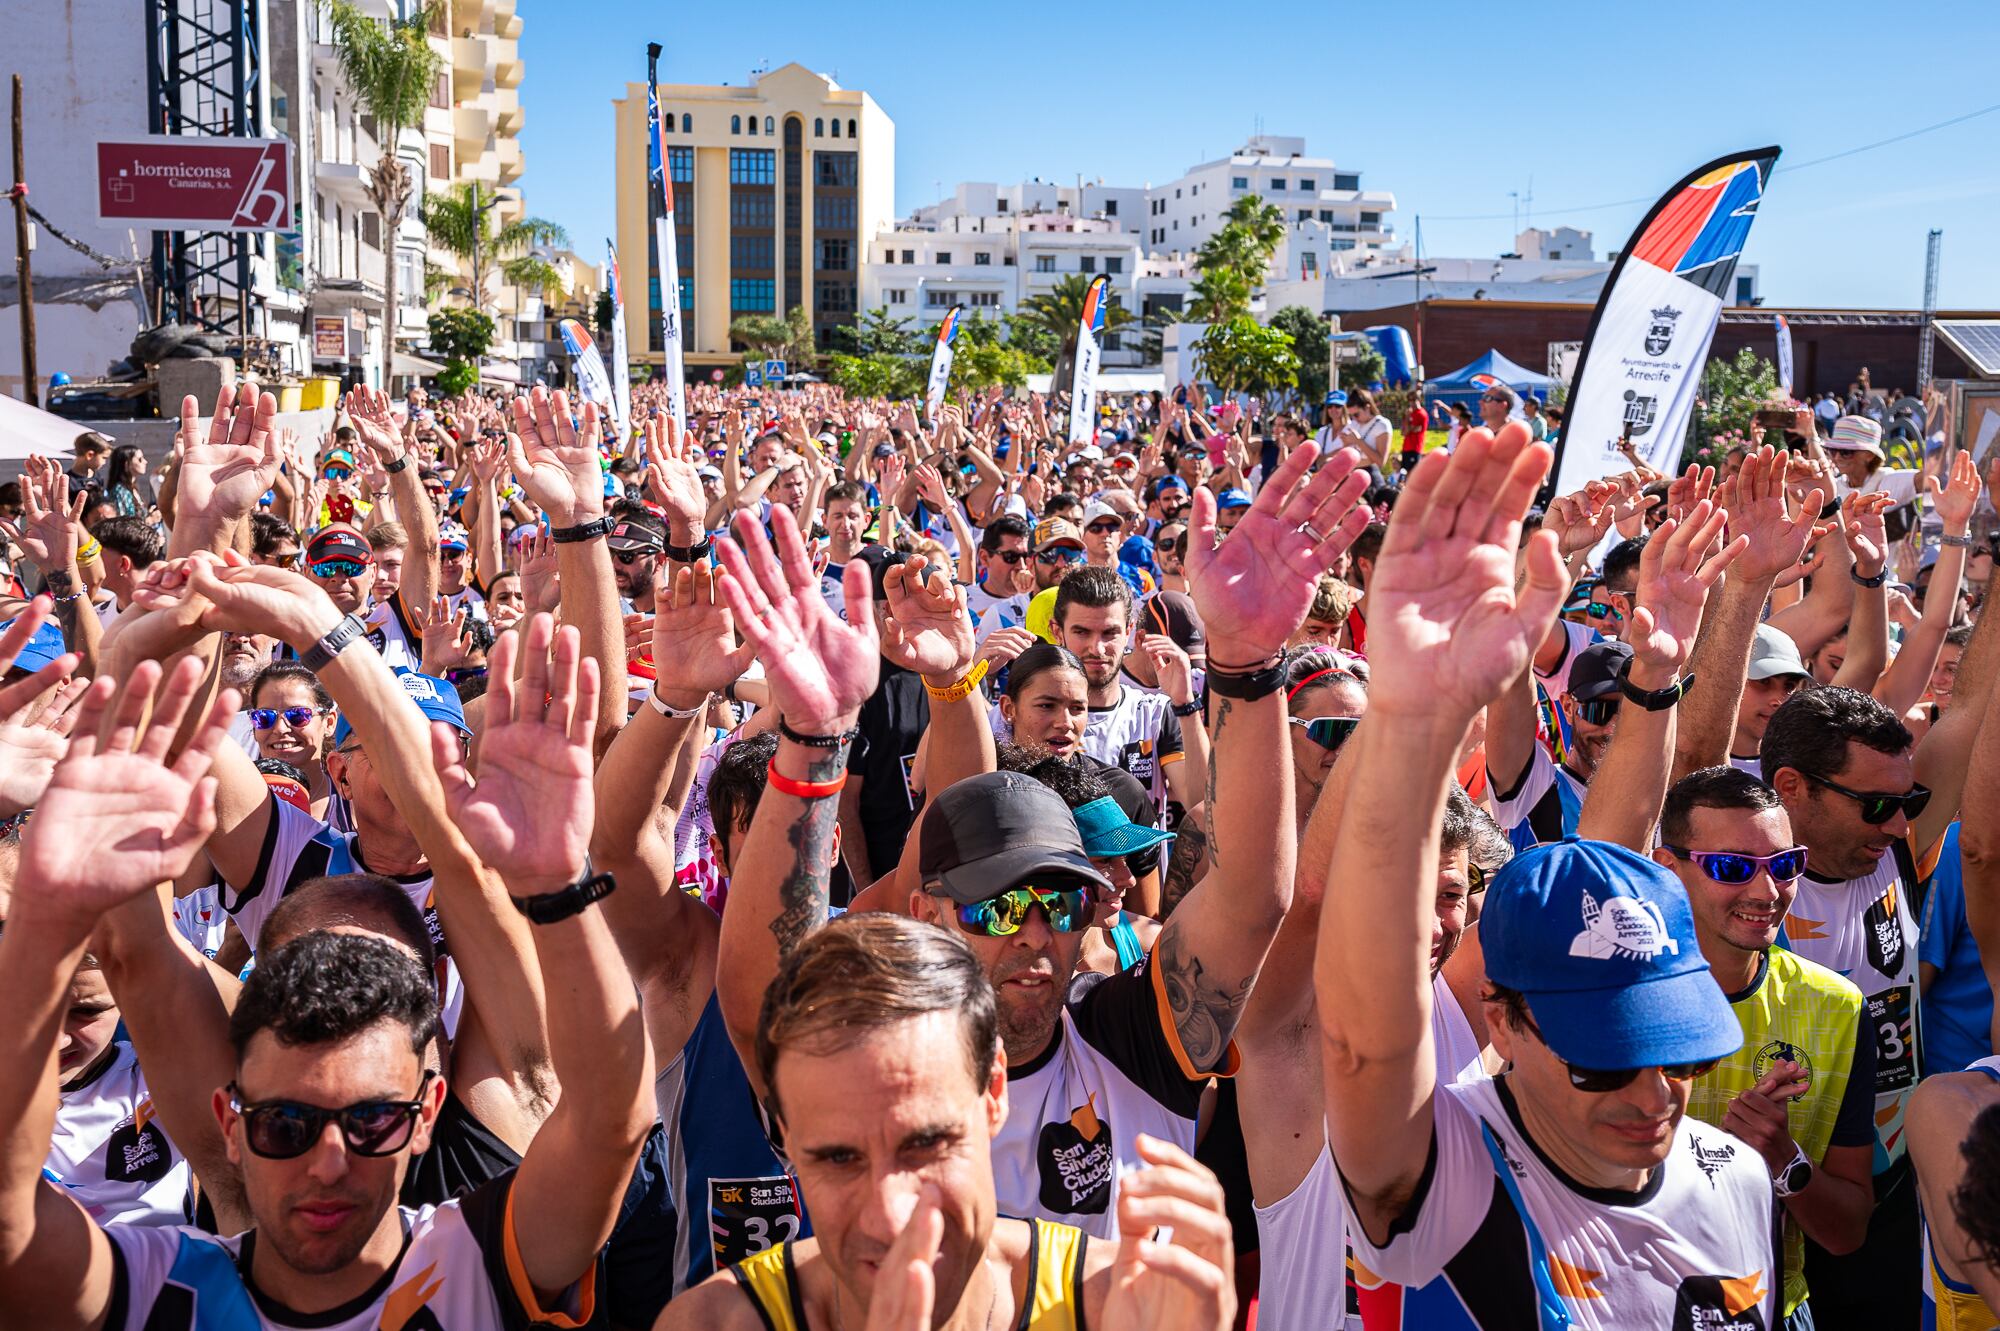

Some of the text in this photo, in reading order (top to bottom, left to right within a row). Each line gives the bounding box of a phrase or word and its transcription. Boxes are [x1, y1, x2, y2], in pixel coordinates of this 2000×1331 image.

[134, 160, 232, 179] hormiconsa
[168, 178, 215, 190] Canarias,
[1621, 357, 1671, 370] Ayuntamiento
[1625, 367, 1672, 383] Arrecife
[268, 784, 296, 798] wer
[1611, 908, 1629, 917] San
[1618, 931, 1653, 939] Arrecife
[1868, 999, 1884, 1011] stre
[1871, 1007, 1886, 1018] ecife
[1876, 1022, 1904, 1060] 3
[1876, 1065, 1907, 1078] CASTELLANO
[1052, 1143, 1085, 1161] San
[722, 1188, 744, 1203] 5K
[750, 1185, 793, 1198] San Silv
[750, 1197, 781, 1206] Ciudad
[1691, 1305, 1725, 1322] San
